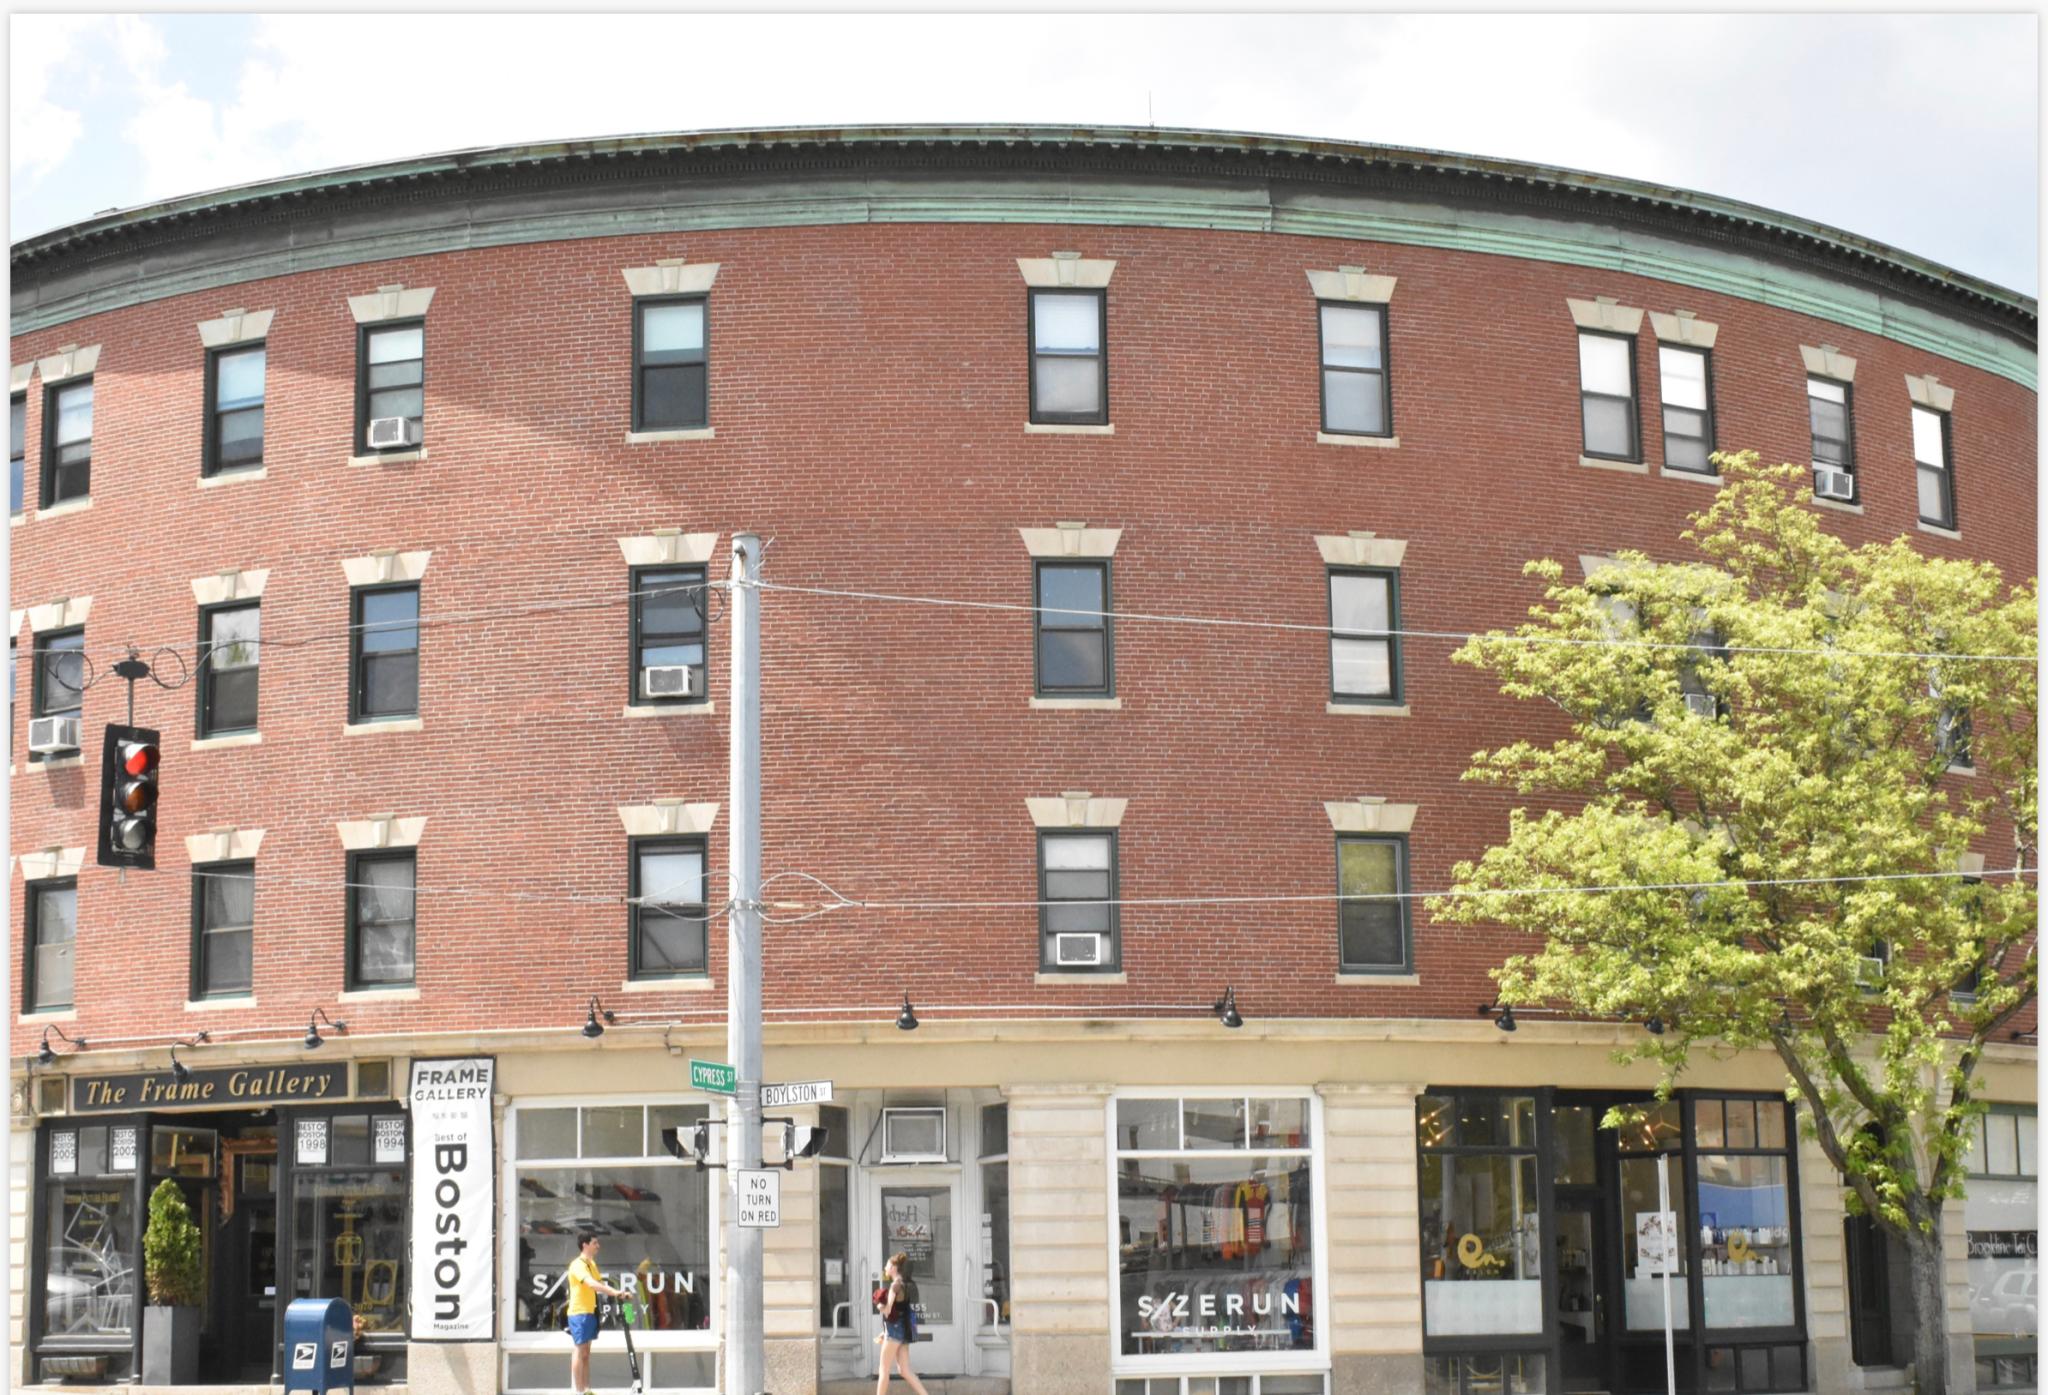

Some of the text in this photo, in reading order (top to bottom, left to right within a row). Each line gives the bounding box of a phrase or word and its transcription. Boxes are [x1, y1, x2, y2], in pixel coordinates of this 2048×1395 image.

[417, 1069, 489, 1086] FRAME
[693, 1065, 733, 1087] CYPRESS ST
[87, 1070, 331, 1105] The Frame Gallery
[415, 1087, 487, 1101] GALLERY
[766, 1084, 817, 1105] BOYLSTON
[457, 1132, 467, 1141] of
[300, 1139, 326, 1150] 1998
[377, 1137, 404, 1149] 1994
[751, 1178, 767, 1190] NO
[747, 1194, 771, 1206] TURN
[741, 1210, 777, 1222] ON RED
[434, 1143, 467, 1320] Boston
[434, 1323, 470, 1331] Magazine
